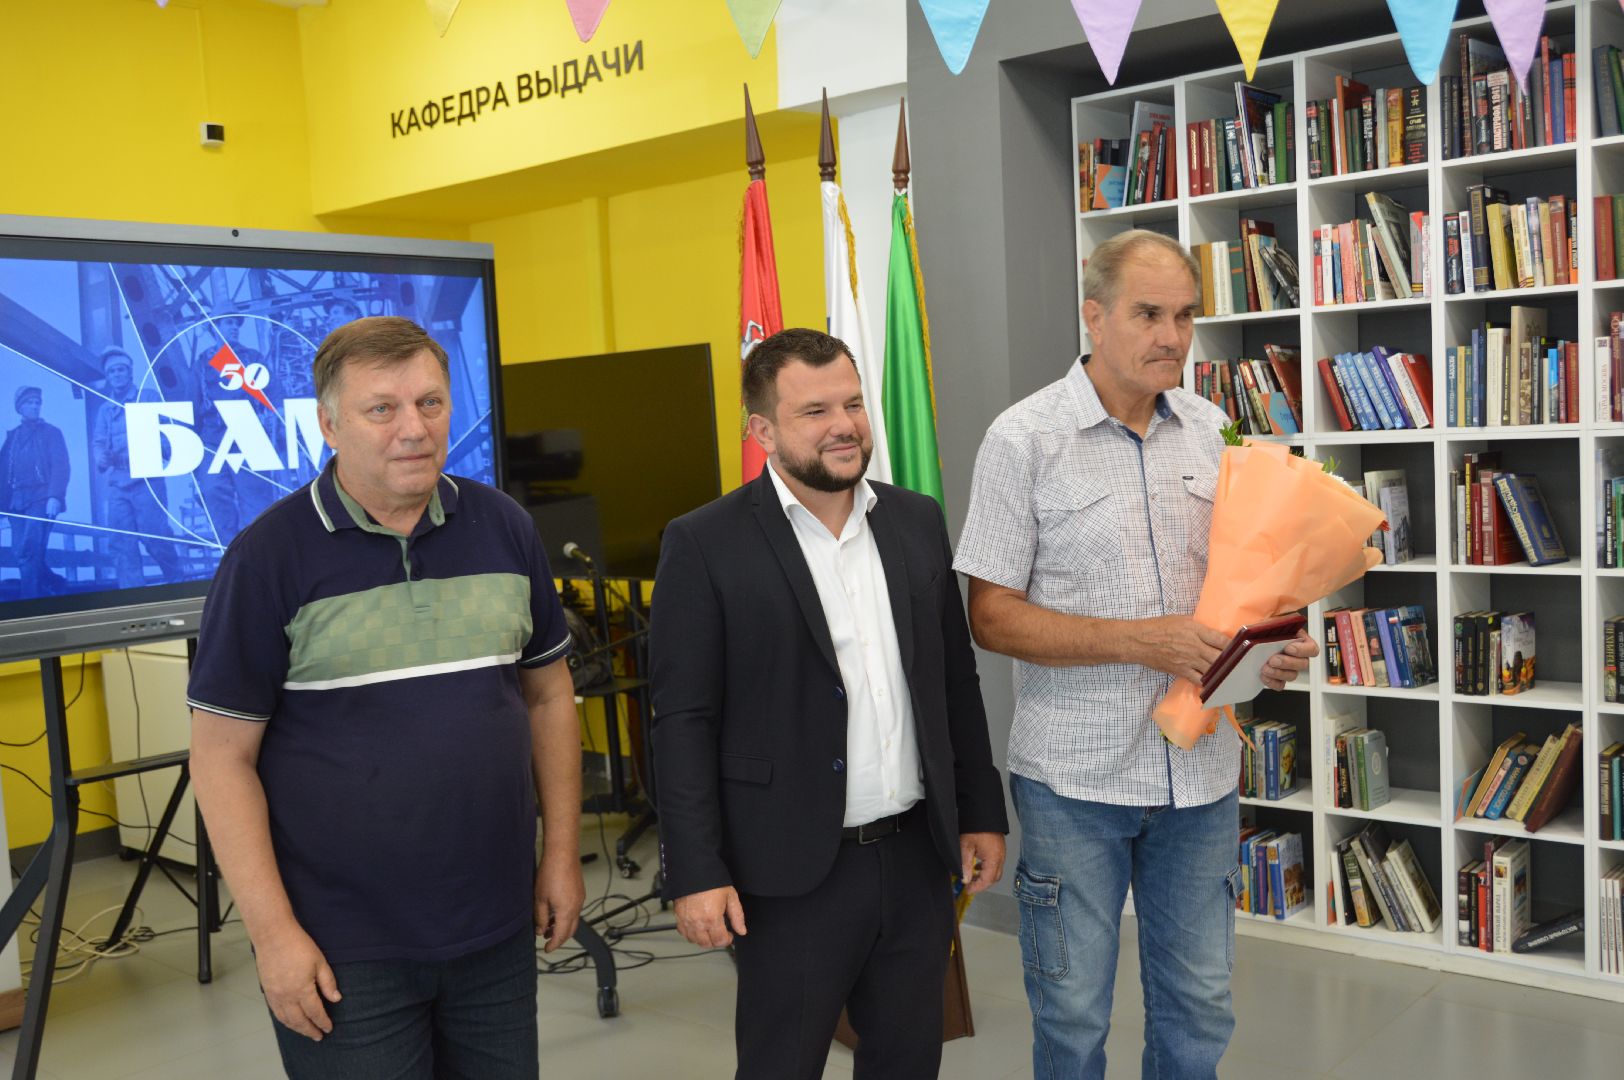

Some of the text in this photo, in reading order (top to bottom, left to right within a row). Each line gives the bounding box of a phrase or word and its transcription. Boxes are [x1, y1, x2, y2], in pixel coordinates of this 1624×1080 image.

[390, 40, 645, 138] КАФЕДРА ВЫДАЧИ
[218, 362, 270, 390] 50
